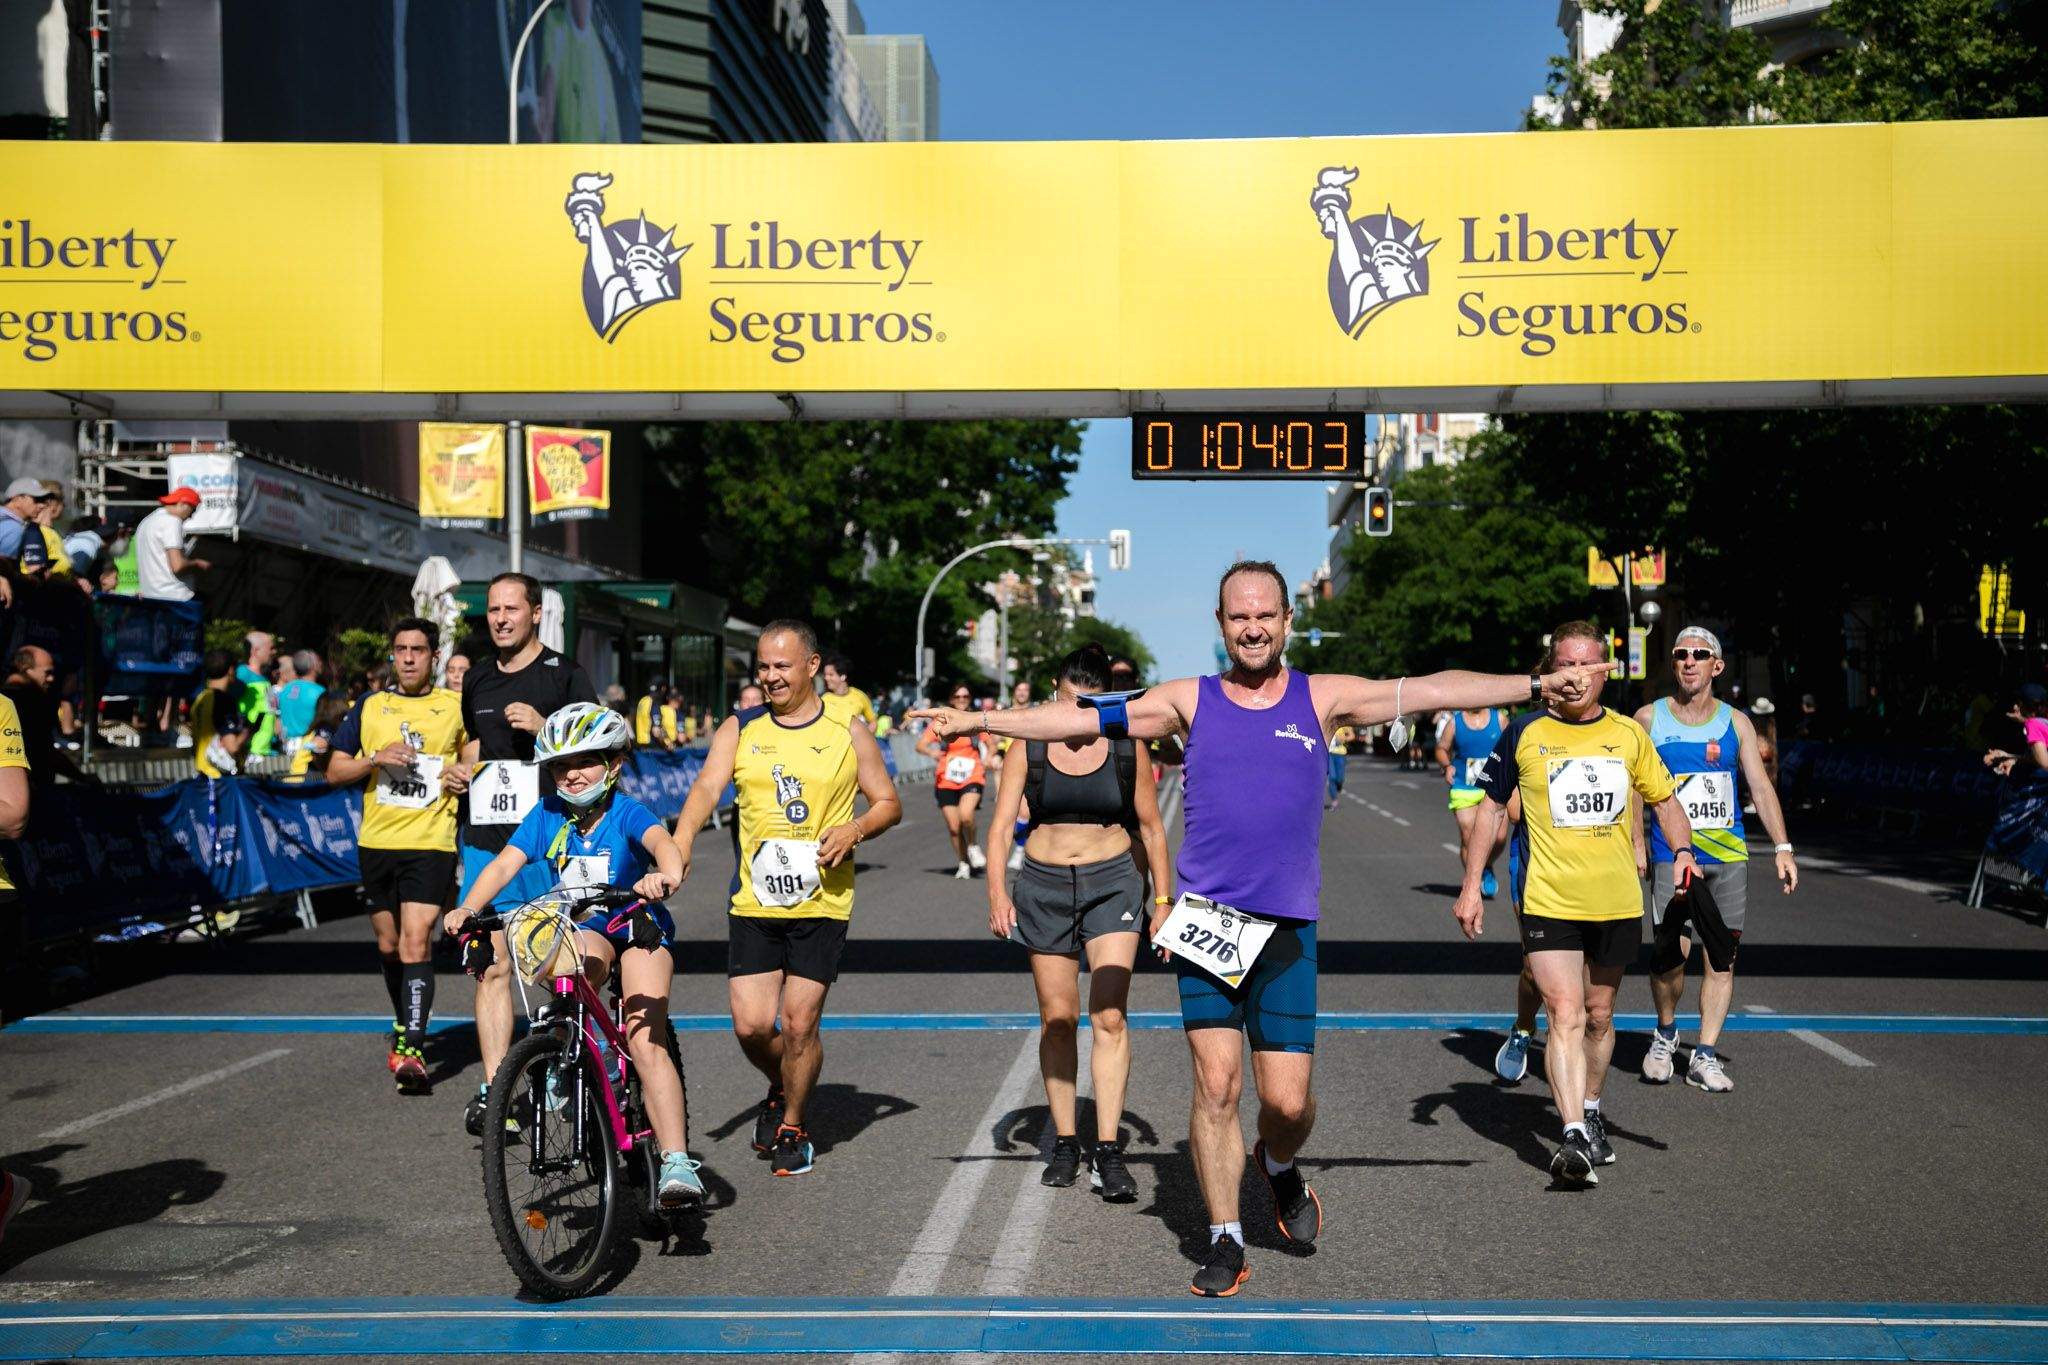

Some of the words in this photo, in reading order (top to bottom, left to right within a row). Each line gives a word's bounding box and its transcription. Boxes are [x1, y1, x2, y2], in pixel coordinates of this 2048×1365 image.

[0, 219, 178, 290] iberty
[711, 221, 923, 292] Liberty
[1459, 213, 1680, 281] Liberty
[390, 780, 427, 799] 2370
[491, 793, 517, 812] 481
[789, 805, 805, 818] 13
[1566, 792, 1614, 814] 3387
[1689, 801, 1727, 819] 3456
[765, 874, 804, 894] 3191
[1179, 923, 1238, 963] 3276
